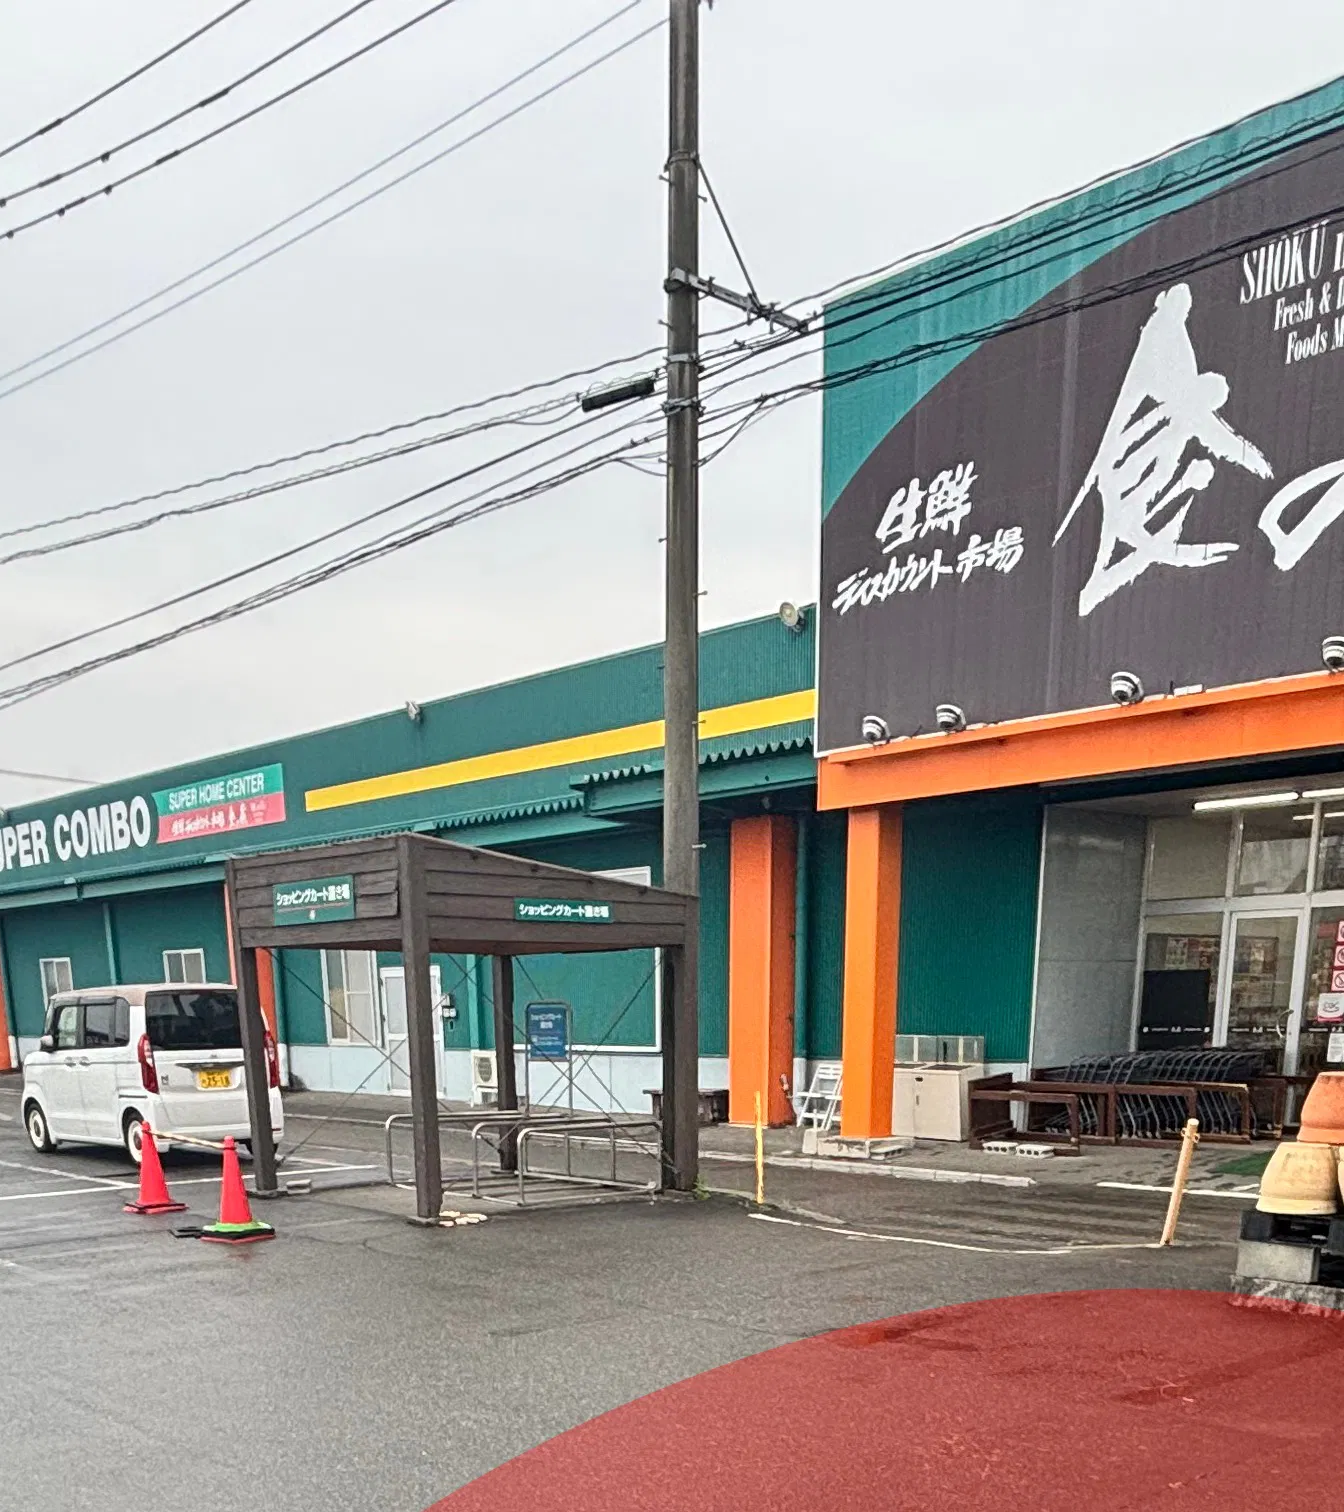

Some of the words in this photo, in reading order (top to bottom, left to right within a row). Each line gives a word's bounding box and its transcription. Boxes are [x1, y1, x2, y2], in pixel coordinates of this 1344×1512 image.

[1239, 218, 1330, 305] SHOKU
[1273, 288, 1314, 331] Fresh
[1318, 280, 1332, 315] &
[1285, 322, 1328, 365] Foods
[875, 460, 979, 555] 生鮮
[168, 791, 199, 811] SUPER
[198, 780, 226, 804] HOME
[226, 771, 265, 798] CENTER
[53, 795, 152, 861] COMBO
